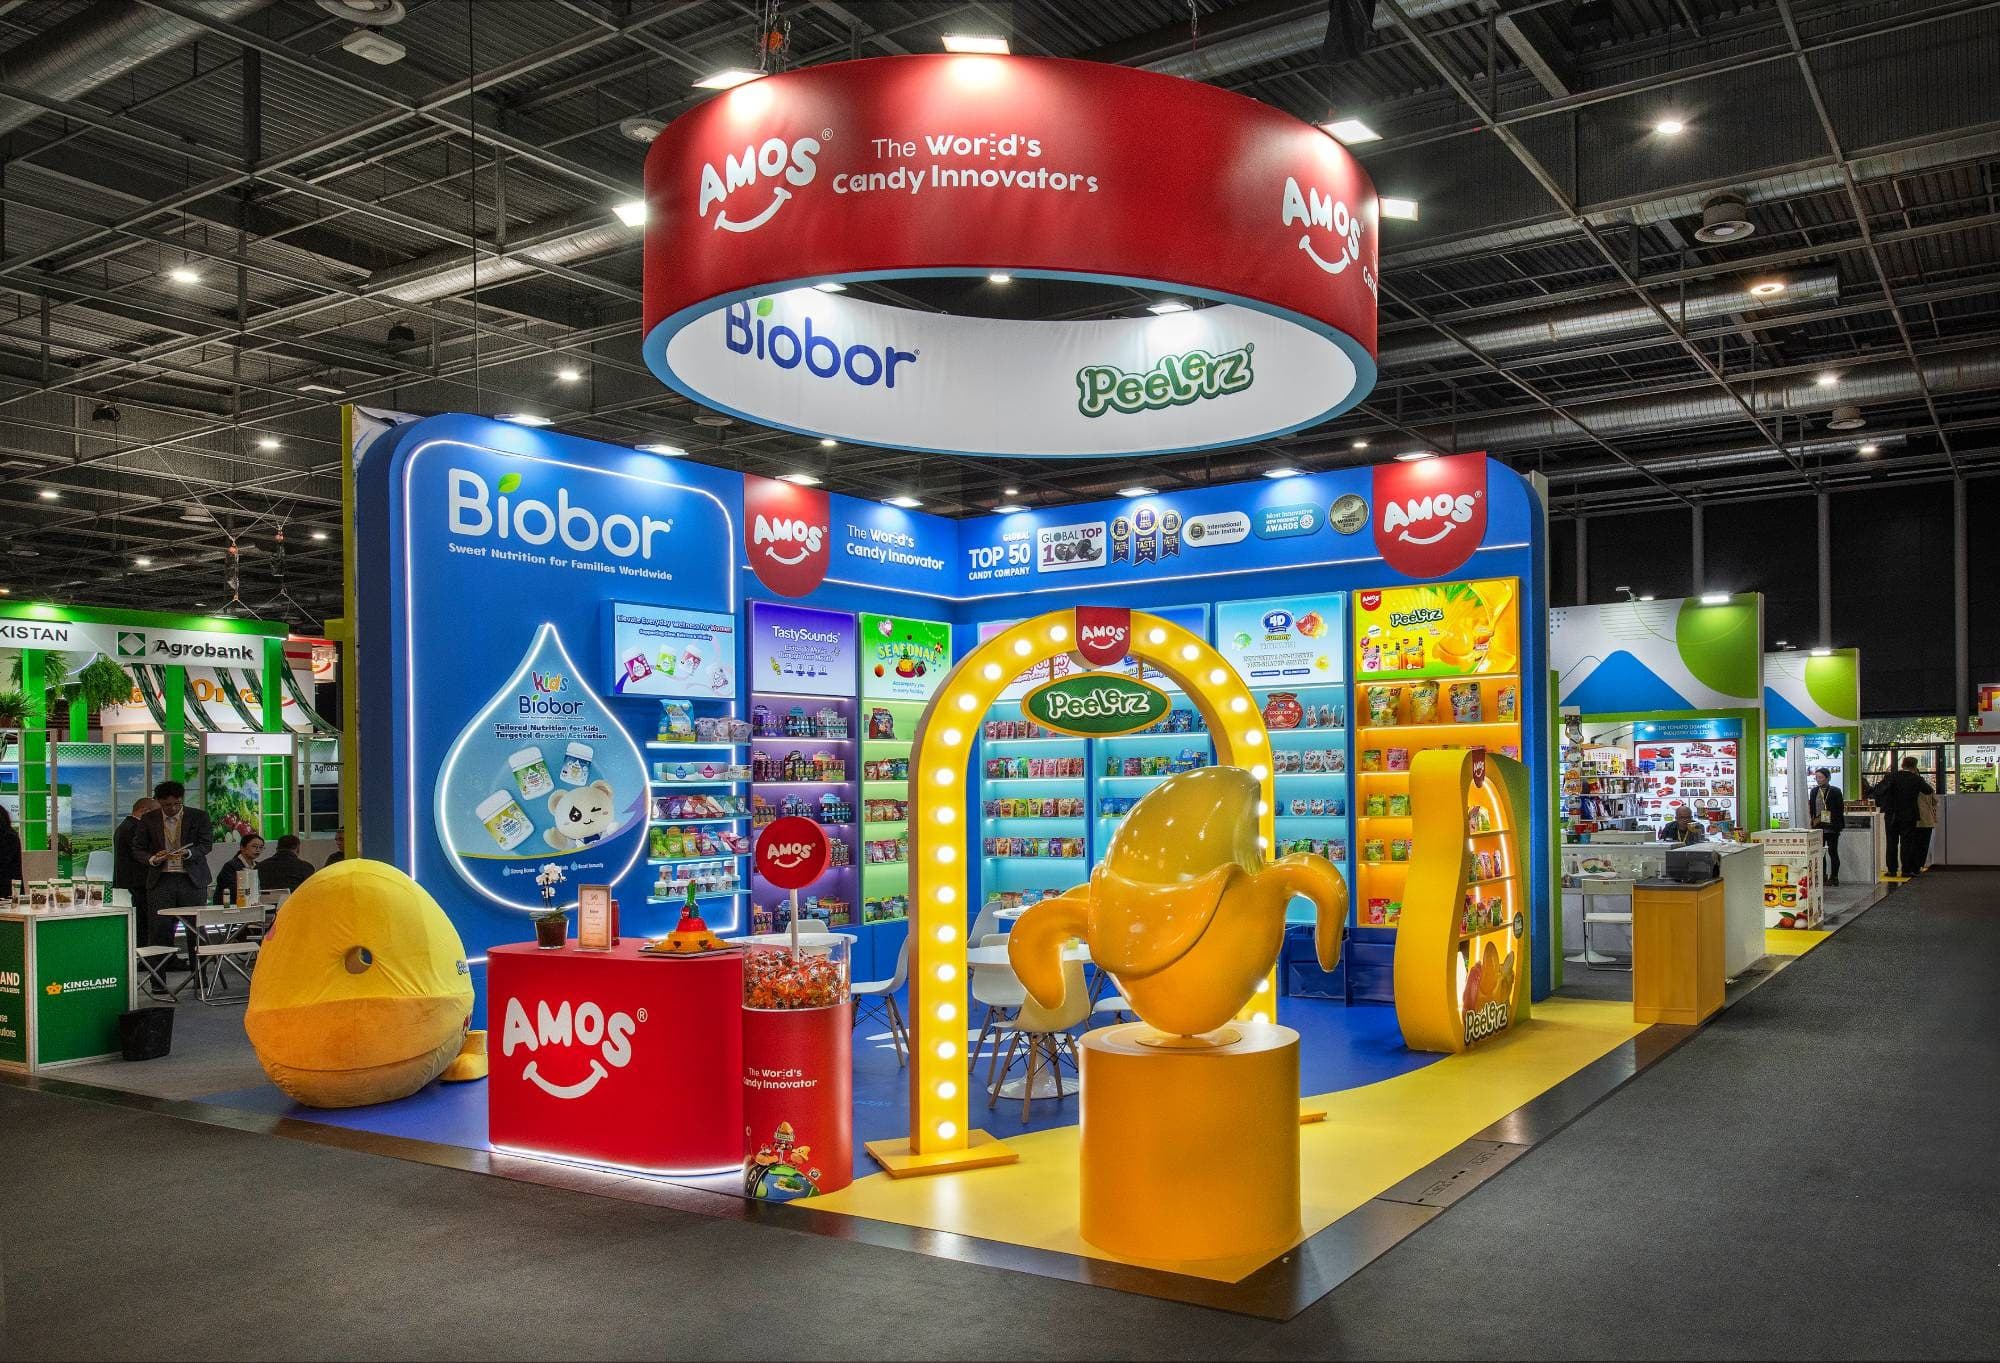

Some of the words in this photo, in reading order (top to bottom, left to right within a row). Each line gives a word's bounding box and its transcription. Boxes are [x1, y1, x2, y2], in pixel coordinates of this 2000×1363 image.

[872, 138, 916, 159] The
[700, 138, 820, 217] AMOS
[932, 165, 1098, 192] Innovators
[1282, 176, 1360, 260] AMOS
[726, 302, 917, 389] Biobor
[1077, 349, 1253, 418] Peelerz
[449, 468, 672, 559] Biobor
[1384, 493, 1475, 532] AMOS
[754, 514, 822, 552] AMOS
[847, 524, 867, 539] The
[1003, 530, 1030, 542] GLOBAL
[1041, 531, 1079, 544] GLOBAL
[1081, 527, 1103, 540] TOP
[1266, 523, 1299, 533] AWARDS
[1136, 540, 1156, 549] TASTE
[448, 542, 486, 557] Sweet
[491, 548, 546, 565] Nutrition
[549, 556, 568, 568] for
[571, 559, 616, 574] Families
[619, 565, 673, 581] Worldwide
[888, 548, 945, 570] Innovator
[968, 547, 1005, 569] TOP
[1008, 543, 1031, 564] 50
[968, 570, 992, 581] CANDY
[994, 566, 1031, 578] COMPANY
[641, 617, 671, 628] Everyday
[1390, 608, 1444, 628] Peelerz
[0, 626, 68, 642] KISTAN
[772, 625, 838, 643] TastySounds
[1081, 624, 1126, 642] AMOS
[155, 639, 254, 661] Agrobank
[519, 695, 584, 715] Biobor
[1047, 688, 1150, 719] Peelerz
[495, 724, 528, 732] Tailored
[495, 732, 533, 740] Targeted
[535, 732, 565, 740] Growth
[568, 732, 607, 740] Activation
[767, 842, 812, 860] AMOS
[63, 977, 117, 989] KINGLAND
[1464, 1000, 1508, 1044] Peelerz
[503, 997, 636, 1068] AMOS
[748, 1067, 760, 1077] The
[763, 1079, 818, 1089] Innovator
